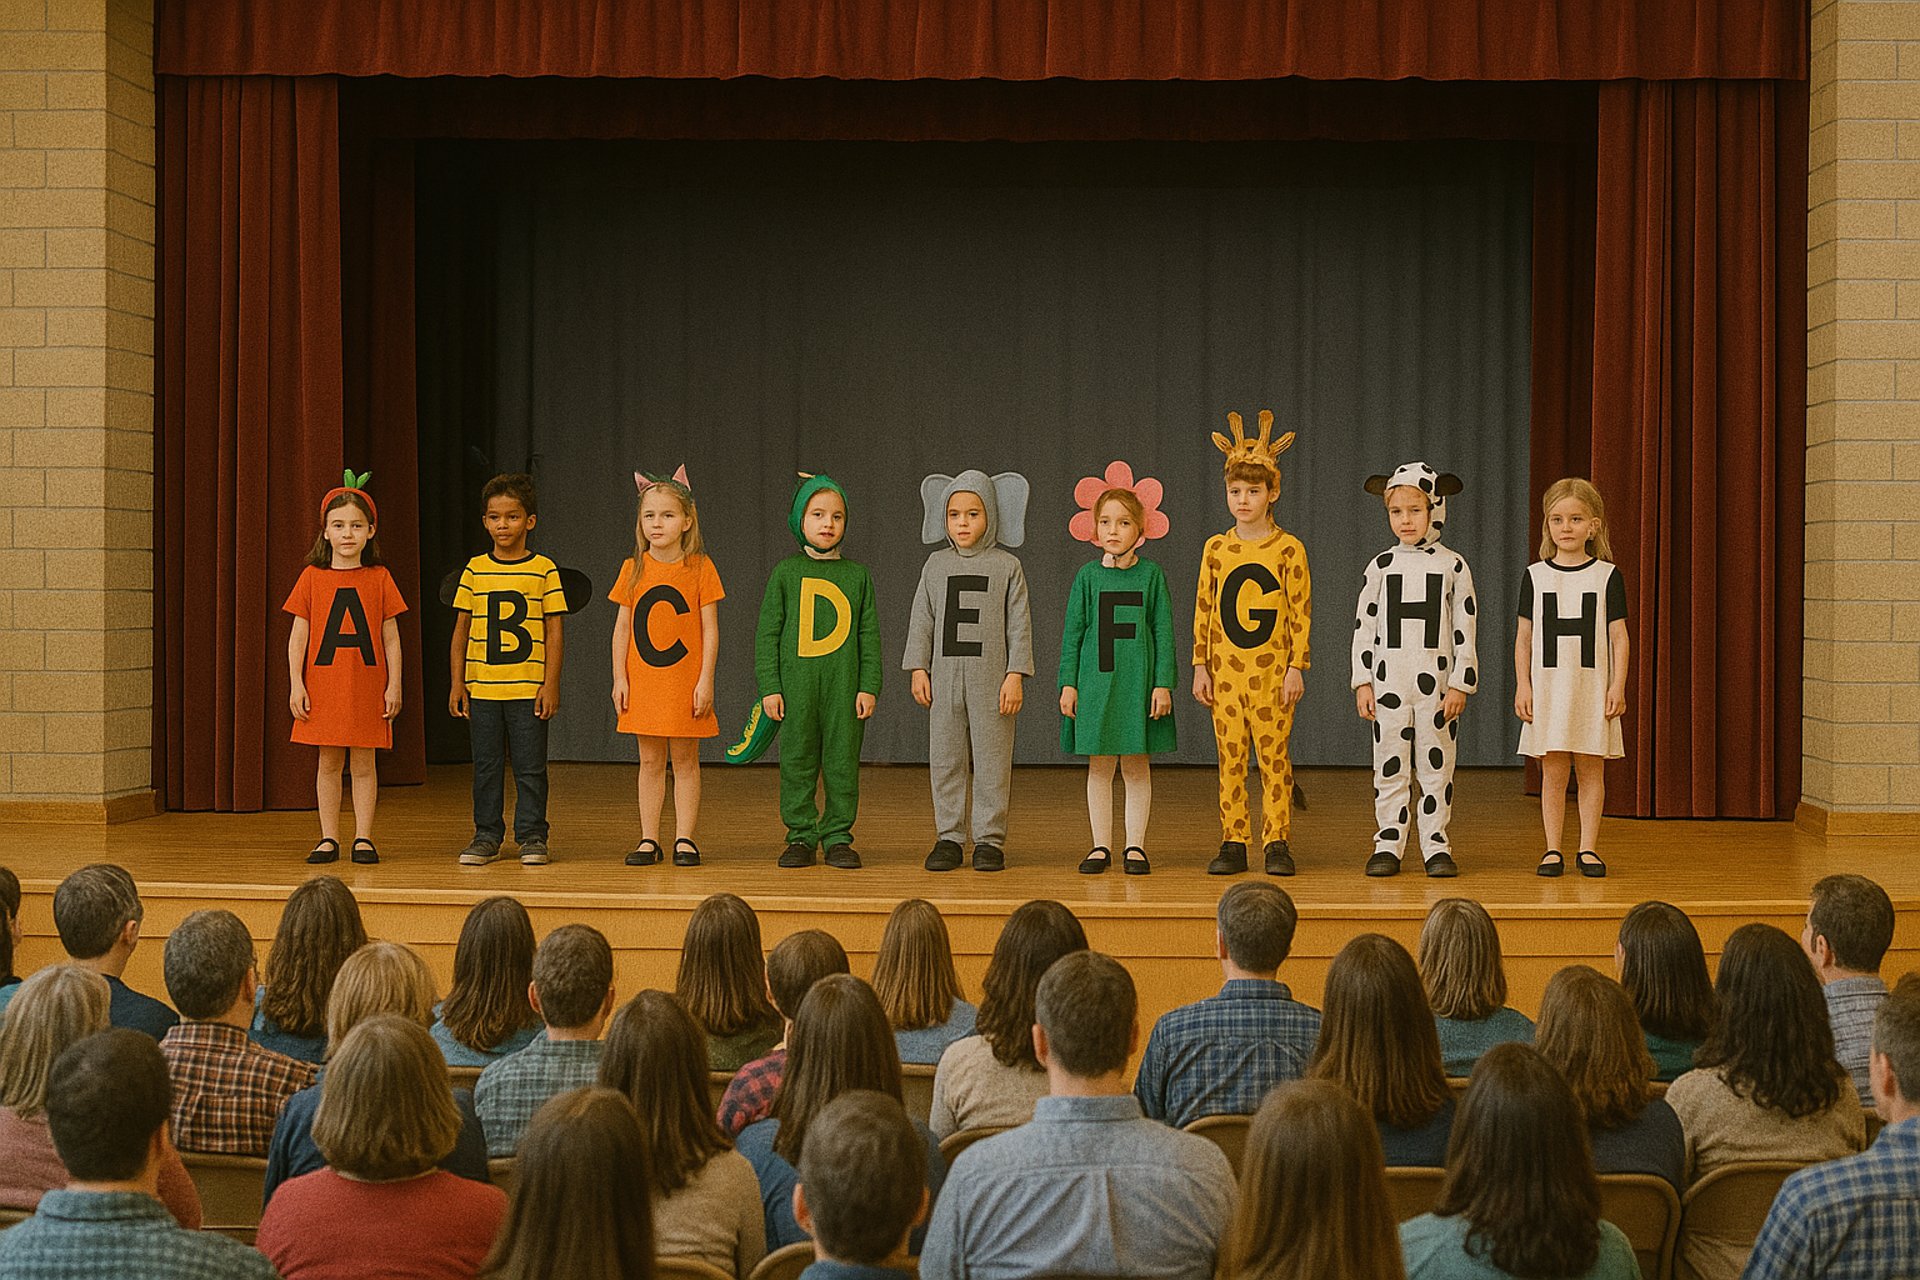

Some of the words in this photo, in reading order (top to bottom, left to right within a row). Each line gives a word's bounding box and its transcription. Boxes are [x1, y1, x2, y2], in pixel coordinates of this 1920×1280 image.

[314, 587, 377, 666] A
[486, 590, 533, 666] B
[633, 584, 690, 667] C
[797, 577, 852, 657] D
[942, 575, 989, 657] E
[1099, 591, 1143, 672] F
[1220, 562, 1281, 649] G
[1386, 573, 1444, 649] H
[1542, 592, 1597, 668] H
